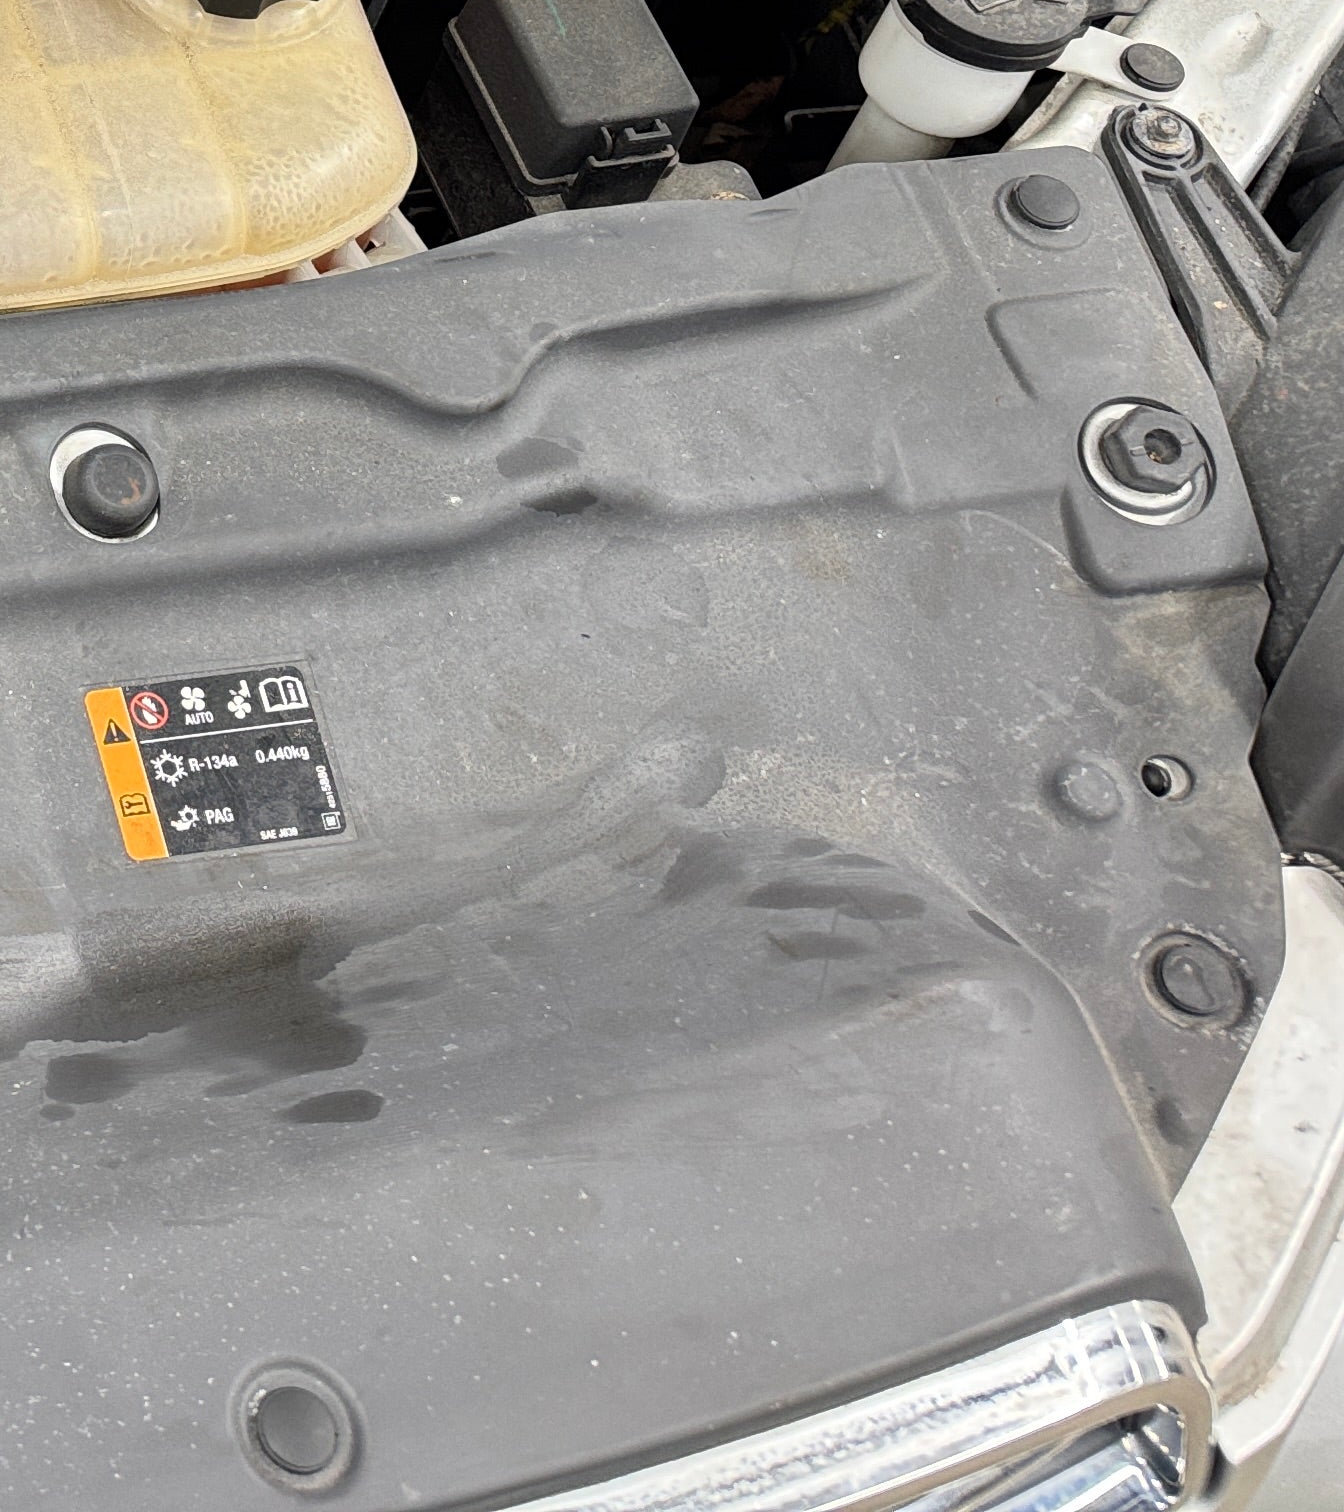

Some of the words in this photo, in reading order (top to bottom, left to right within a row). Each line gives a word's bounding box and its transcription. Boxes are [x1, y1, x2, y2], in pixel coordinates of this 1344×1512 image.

[185, 711, 214, 726] AUTO
[188, 755, 239, 772] R-134a
[255, 744, 310, 763] 0.440kg
[204, 806, 234, 825] PAG
[259, 829, 278, 840] SAE
